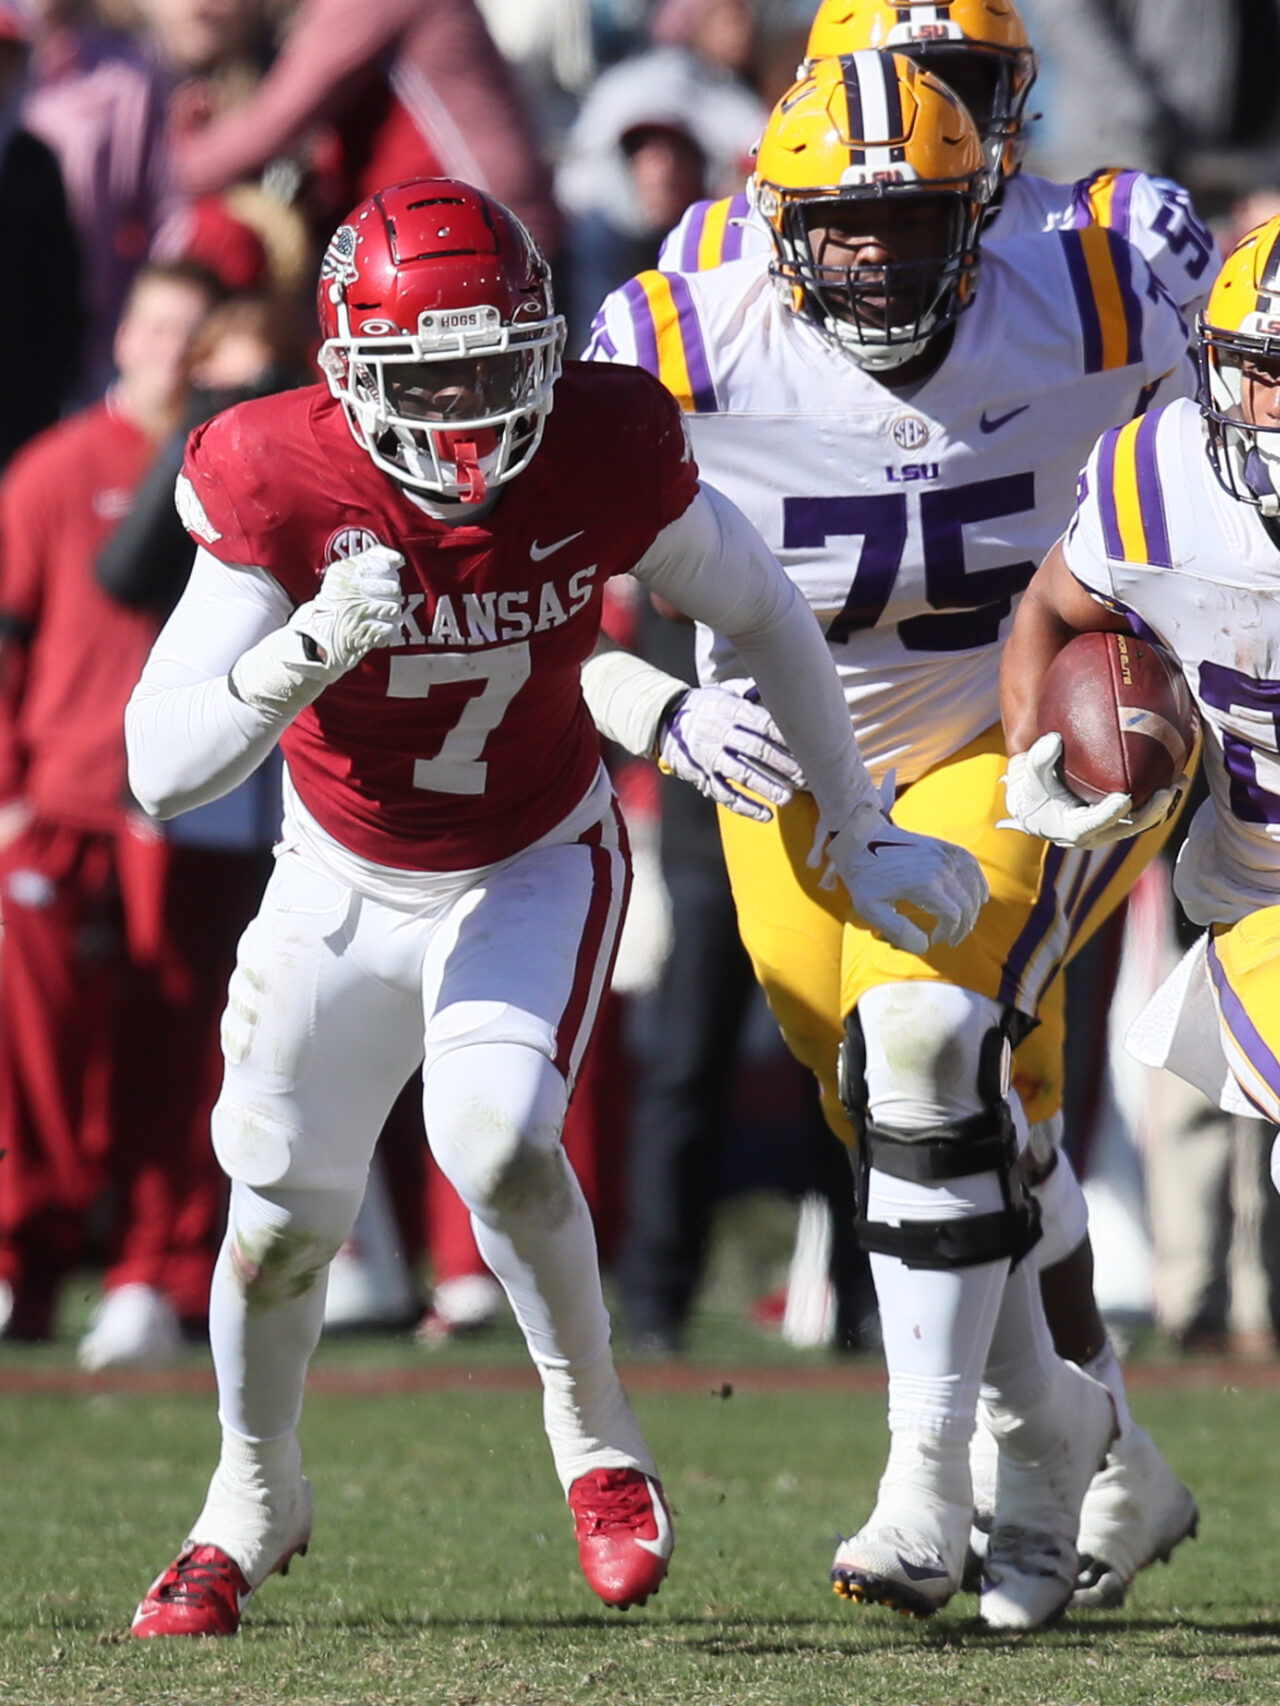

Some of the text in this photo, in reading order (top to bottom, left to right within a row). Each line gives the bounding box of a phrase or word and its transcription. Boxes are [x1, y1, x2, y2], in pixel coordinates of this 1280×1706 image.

[908, 24, 950, 40] LSU
[440, 313, 478, 329] HOGS
[885, 462, 940, 483] LSU
[782, 470, 1040, 652] 75
[388, 563, 598, 648] KANSAS
[385, 639, 532, 797] 7
